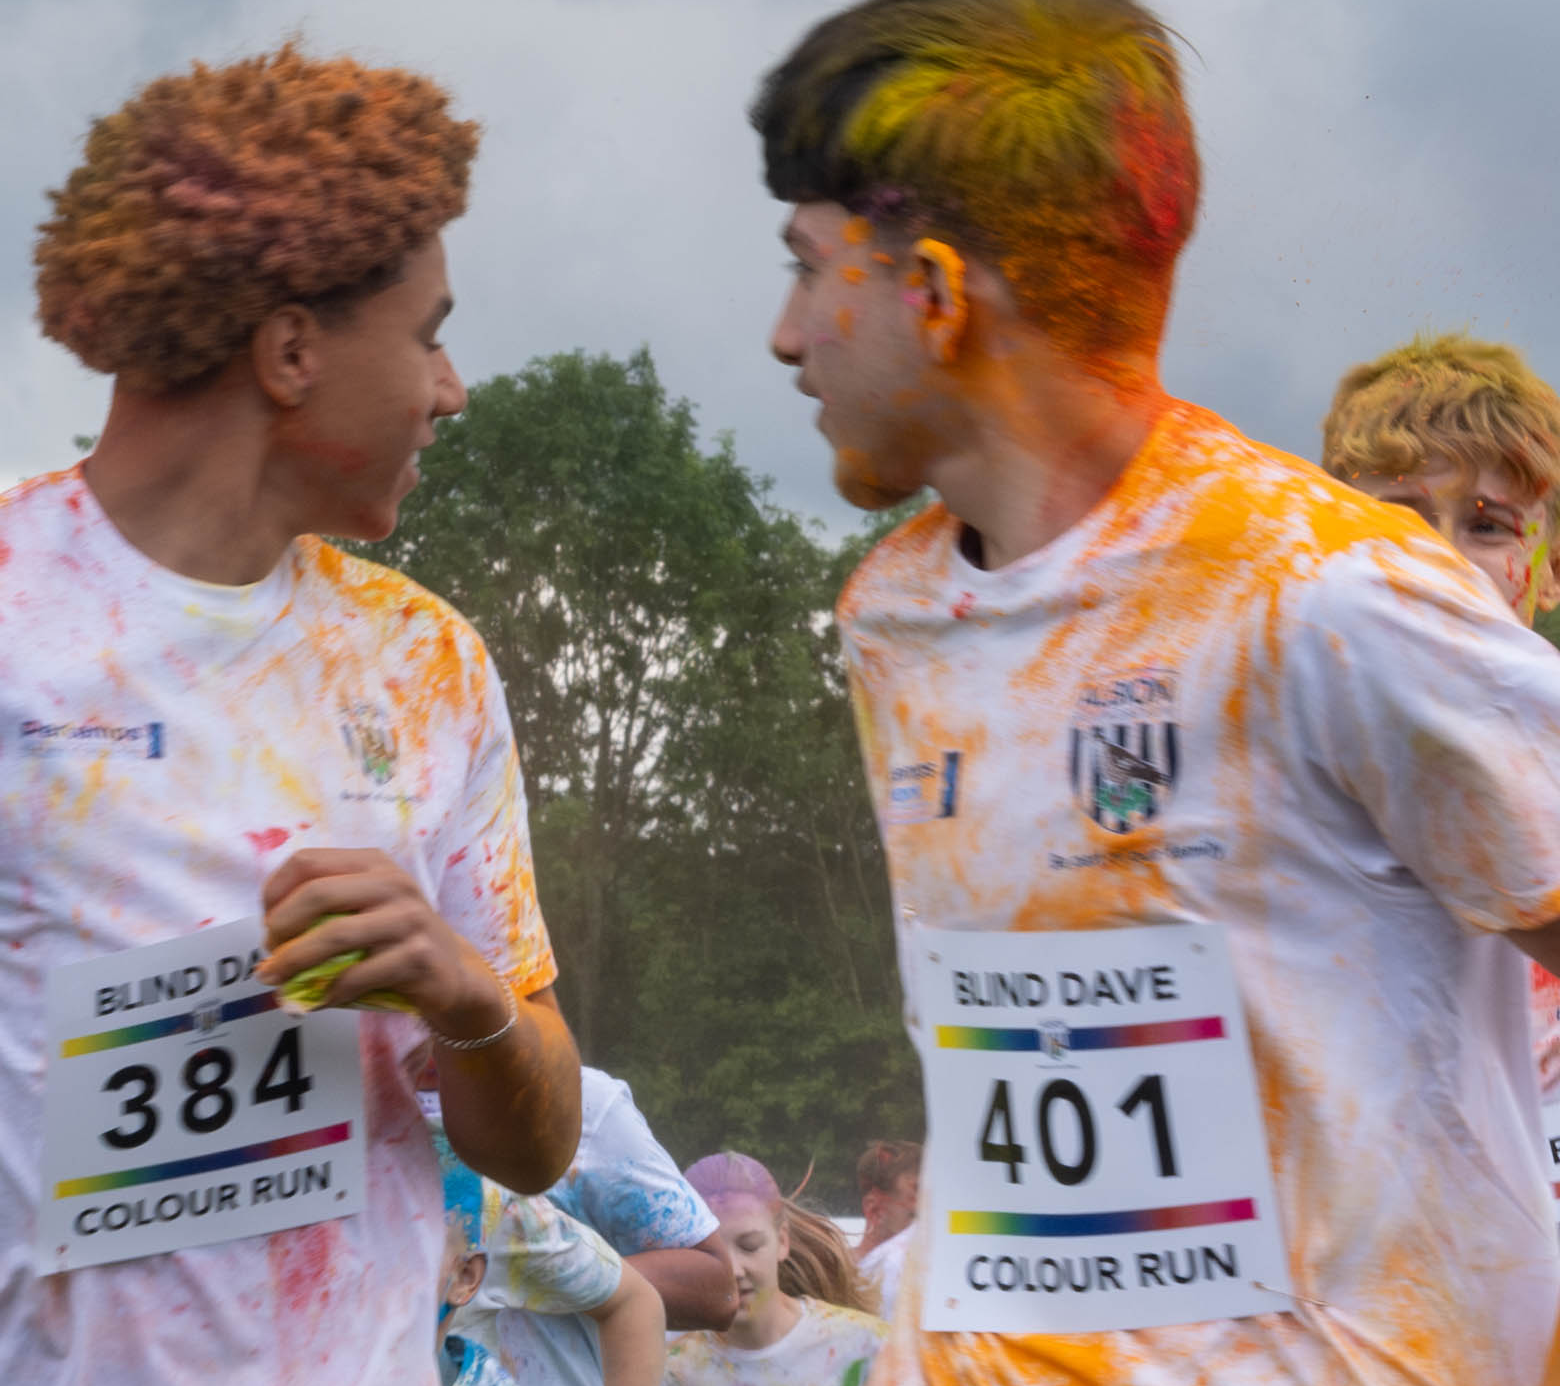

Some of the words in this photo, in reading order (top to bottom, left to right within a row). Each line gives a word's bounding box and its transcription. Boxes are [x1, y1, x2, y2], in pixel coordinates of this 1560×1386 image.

[95, 965, 207, 1017] BLIND
[952, 970, 1049, 1008] BLIND
[1058, 965, 1180, 1006] DAVE
[99, 1024, 314, 1151] 384
[977, 1073, 1181, 1187] 401
[75, 1182, 241, 1236] COLOUR
[251, 1161, 332, 1206] RUN
[965, 1254, 1126, 1293] COLOUR
[1136, 1243, 1240, 1287] RUN
